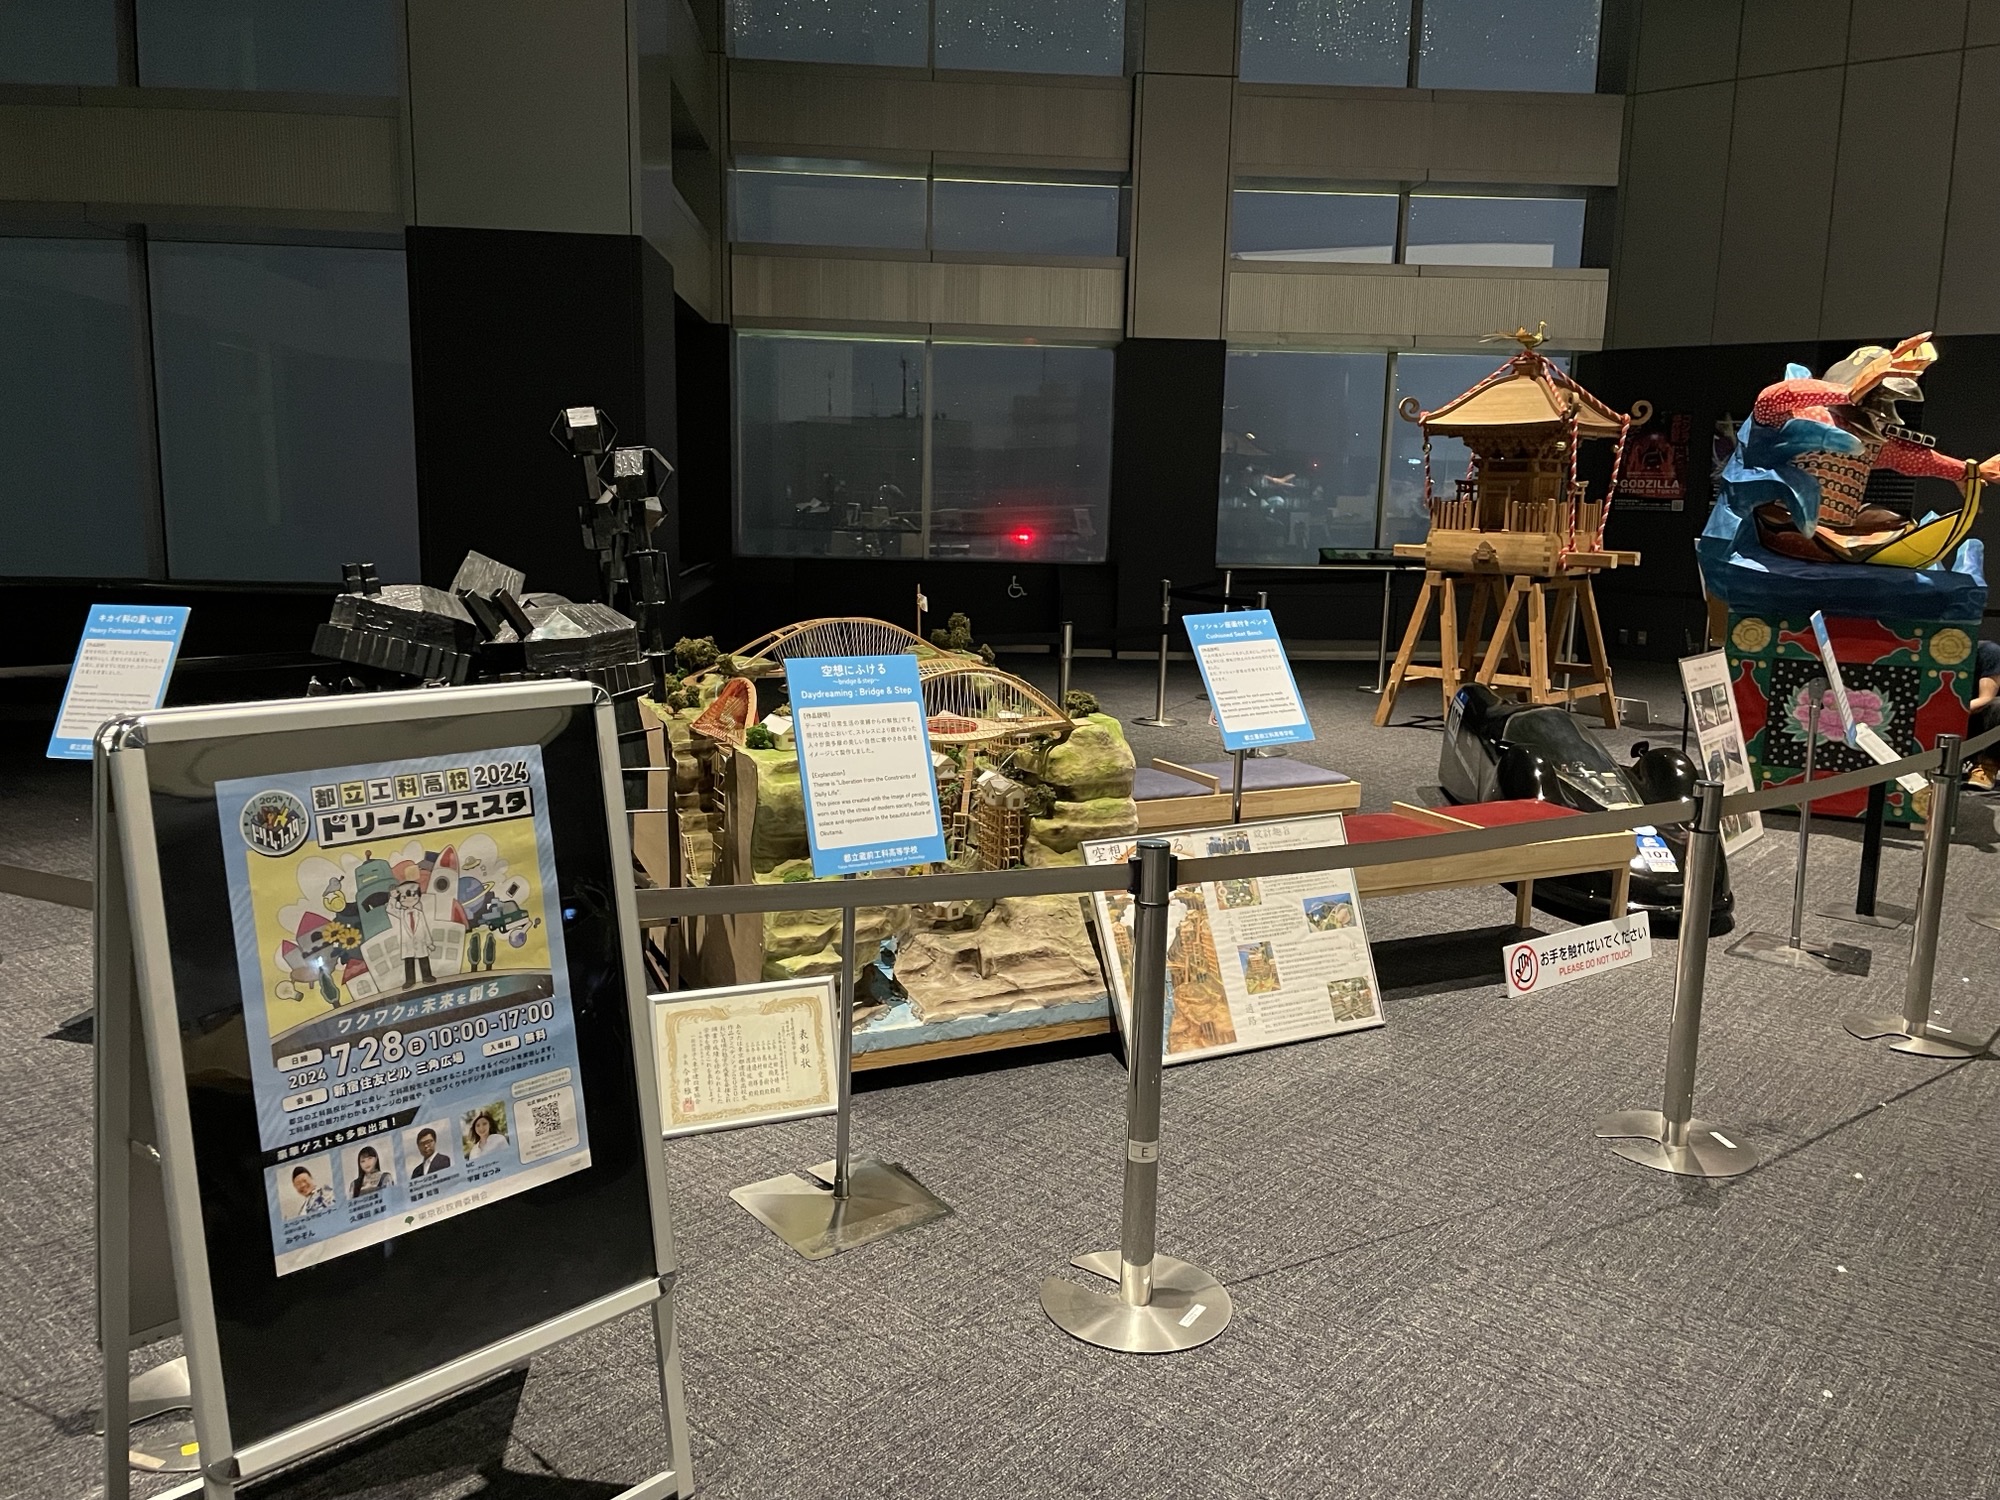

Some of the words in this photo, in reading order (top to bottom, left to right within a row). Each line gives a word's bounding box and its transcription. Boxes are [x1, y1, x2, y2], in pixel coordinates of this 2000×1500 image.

[1620, 479, 1680, 489] GODZILLA
[821, 663, 886, 677] 空想にふける
[801, 689, 853, 700] Daydreaming
[859, 687, 884, 697] Bridge
[886, 686, 893, 694] &
[894, 686, 913, 695] Step
[259, 795, 283, 804] 2024
[314, 768, 470, 808] 都立工科高校
[474, 761, 530, 787] 2024
[321, 790, 528, 842] ドリーム・フェスタ
[1540, 926, 1647, 967] お手を触れないでください
[1559, 961, 1585, 977] PLEASE
[1585, 958, 1595, 969] DO
[1596, 955, 1610, 967] NOT
[1611, 948, 1633, 963] TOUCH
[337, 981, 499, 1034] ワクワクが未来を創る
[428, 1001, 554, 1051] 10:00-17:00
[329, 1030, 404, 1077] 7.28
[524, 1028, 548, 1045] 無料
[800, 1028, 812, 1069] 表彰状
[288, 1067, 327, 1090] 2024
[332, 1067, 412, 1098] 新宿住友ビル
[416, 1050, 466, 1075] 三角広場
